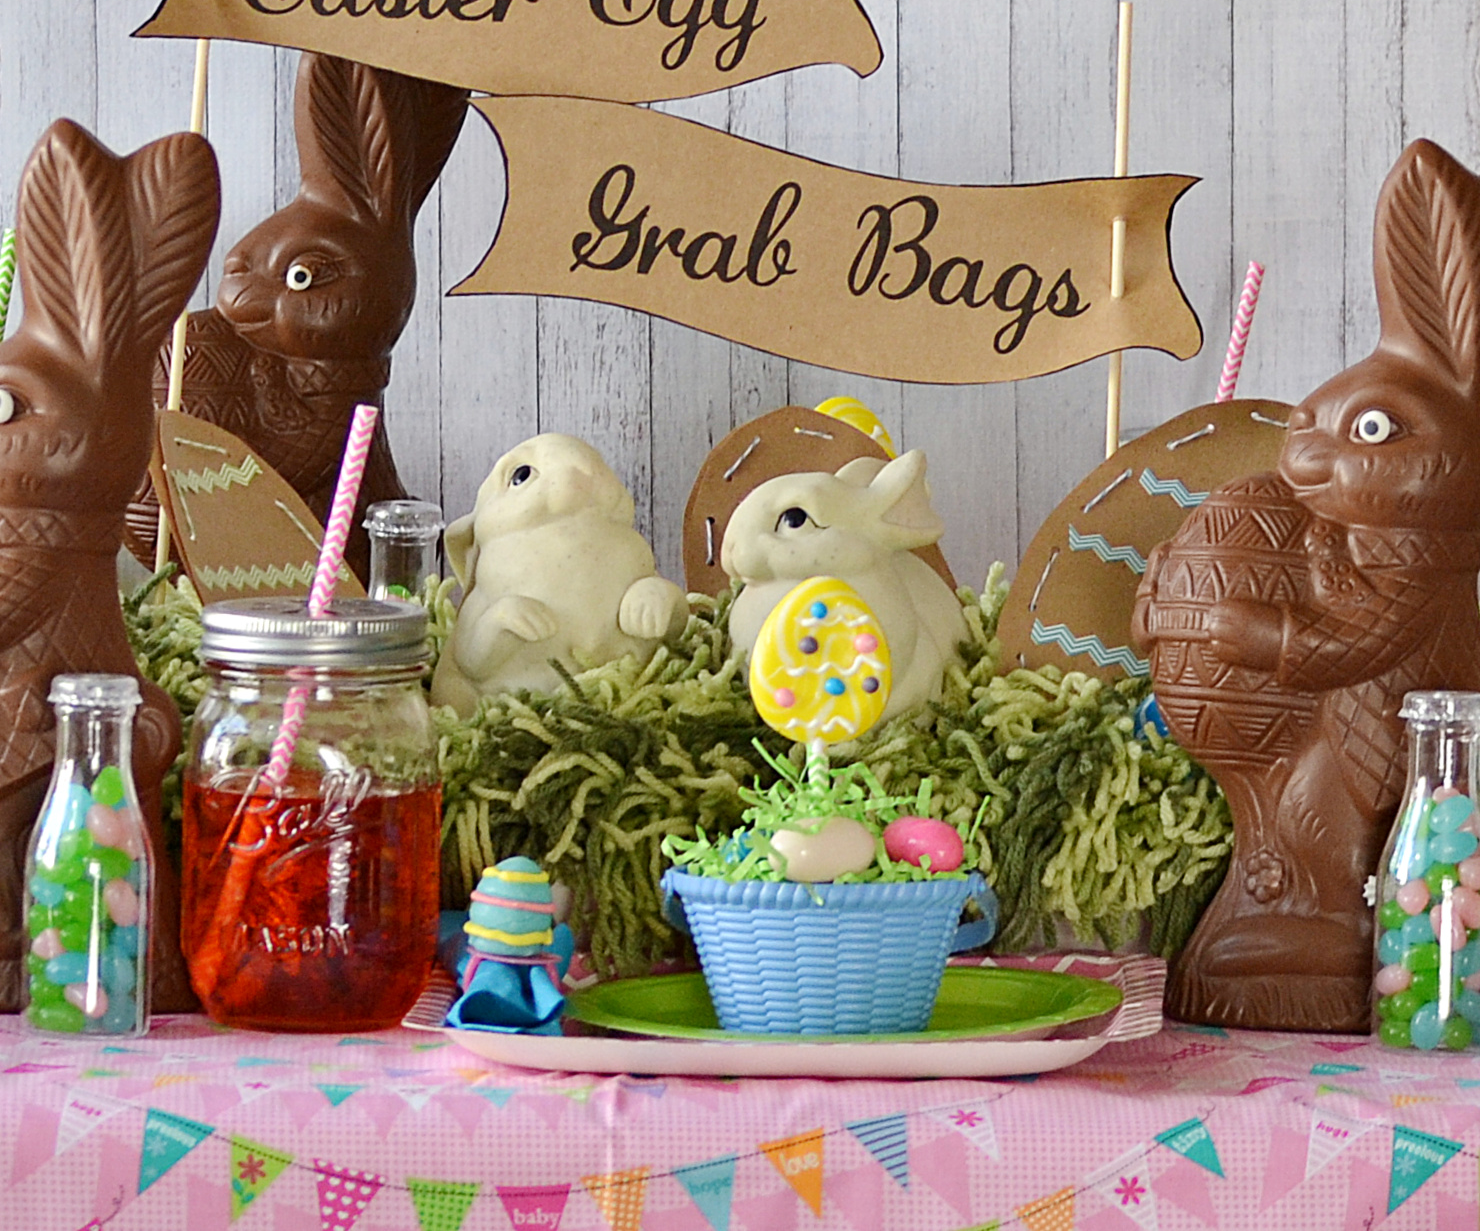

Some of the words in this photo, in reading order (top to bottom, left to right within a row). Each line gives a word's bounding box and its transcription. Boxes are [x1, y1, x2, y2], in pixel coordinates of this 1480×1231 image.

[570, 164, 799, 287] Grab
[848, 195, 1091, 354] Bags
[779, 1151, 820, 1176] love
[513, 1208, 562, 1230] baby
